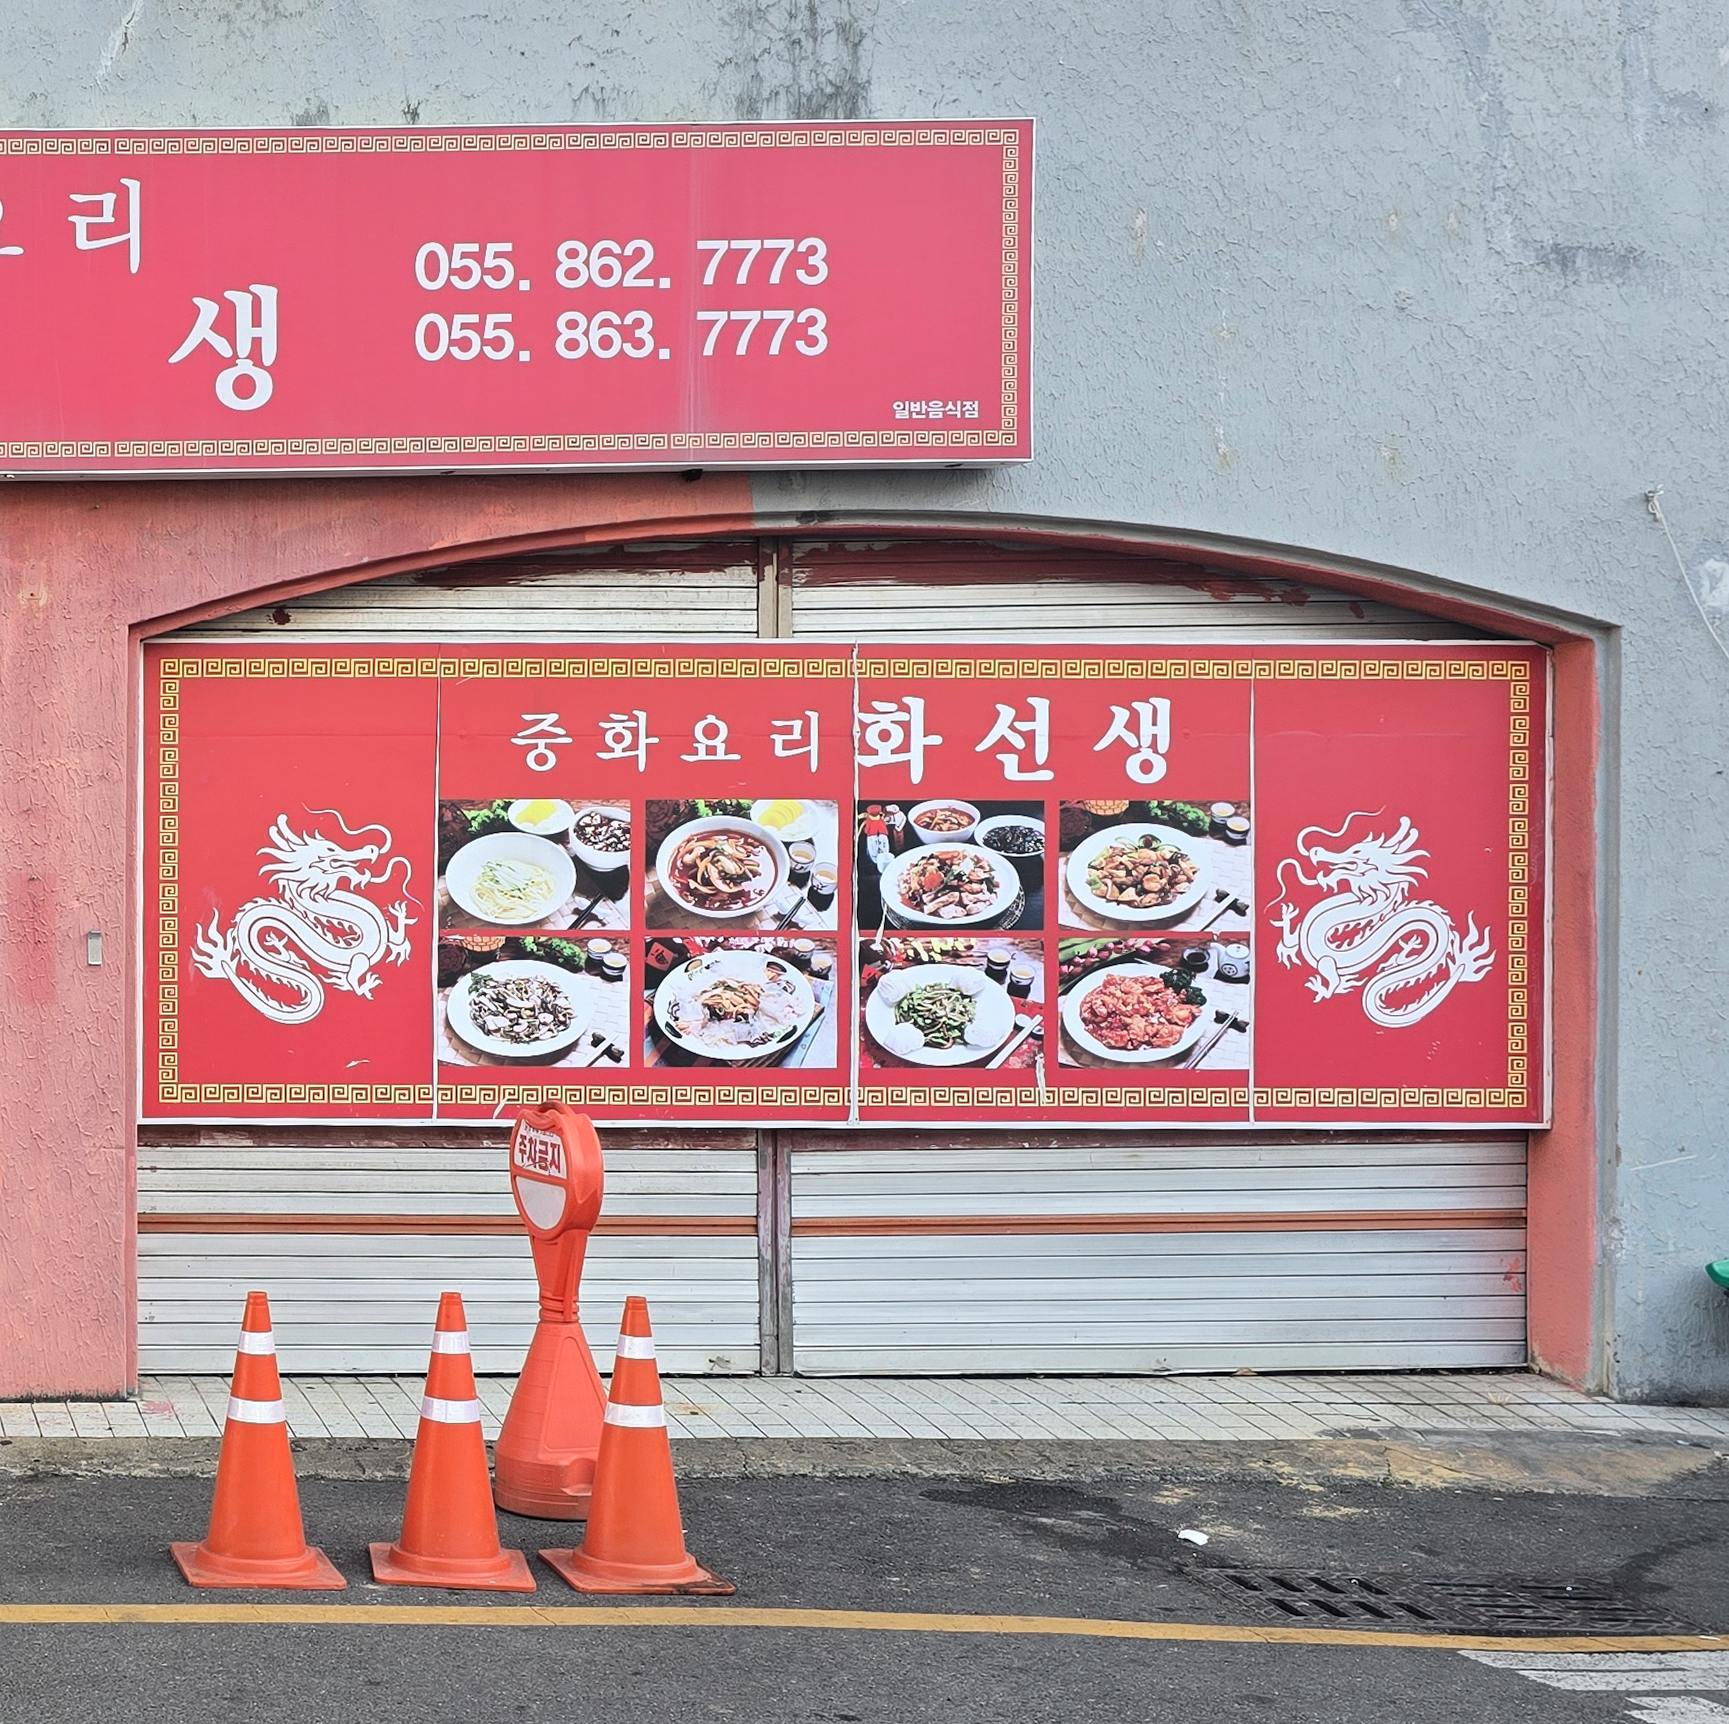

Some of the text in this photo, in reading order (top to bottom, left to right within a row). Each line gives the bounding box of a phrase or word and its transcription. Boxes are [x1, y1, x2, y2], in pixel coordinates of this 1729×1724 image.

[415, 237, 829, 291] 055. 862. 7773
[415, 308, 829, 361] 055. 863. 7773
[893, 400, 979, 419] 일반음식점
[510, 697, 1171, 784] 중화요리 화선생
[518, 1134, 561, 1173] 주차금지
